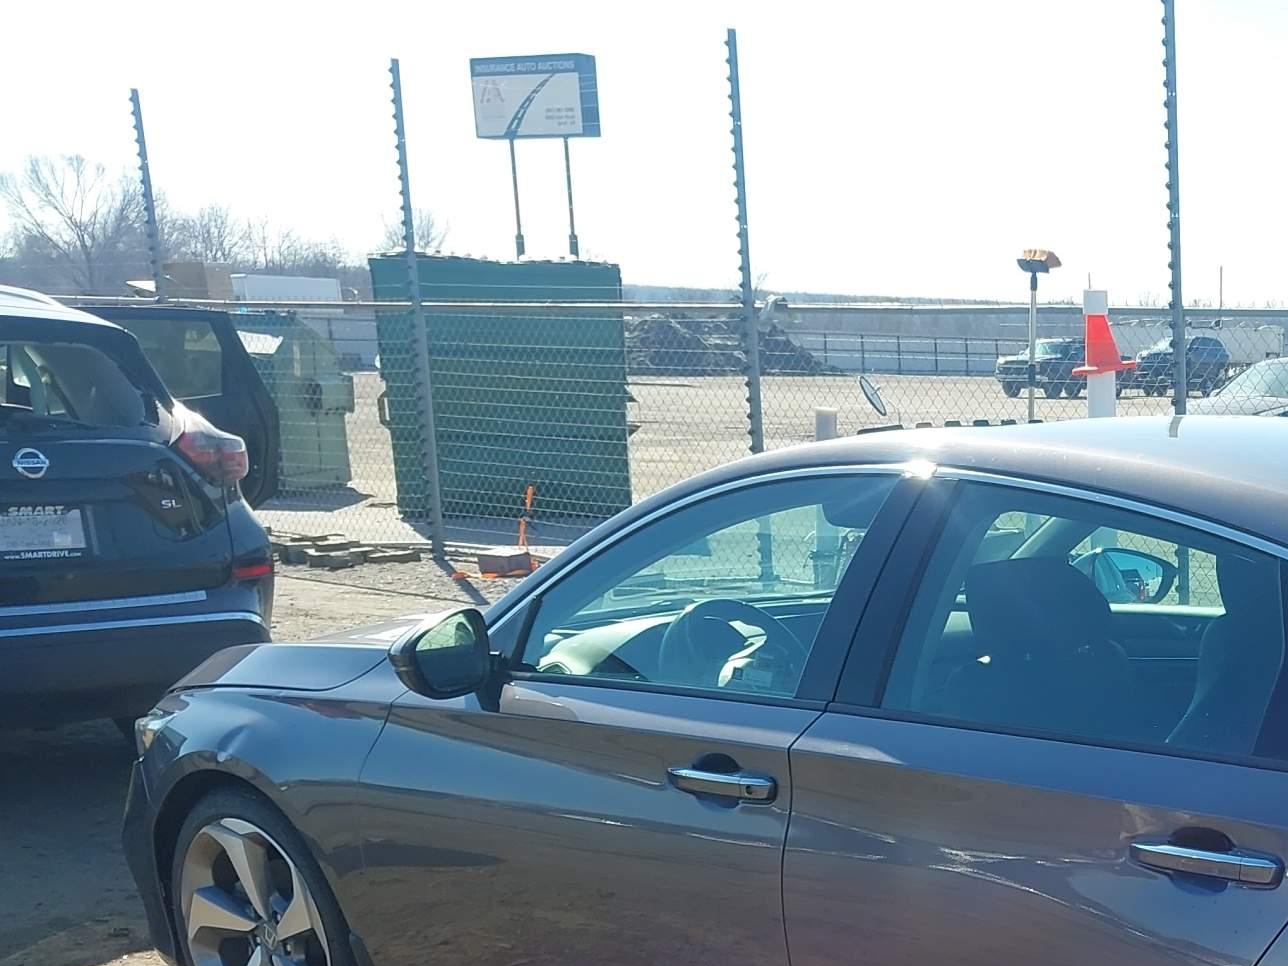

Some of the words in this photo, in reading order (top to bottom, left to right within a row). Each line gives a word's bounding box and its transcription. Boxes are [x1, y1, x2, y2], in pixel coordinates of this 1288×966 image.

[516, 62, 536, 71] AUTO
[538, 60, 575, 69] AUCTIONS
[161, 499, 182, 509] SL
[8, 505, 65, 516] SMART
